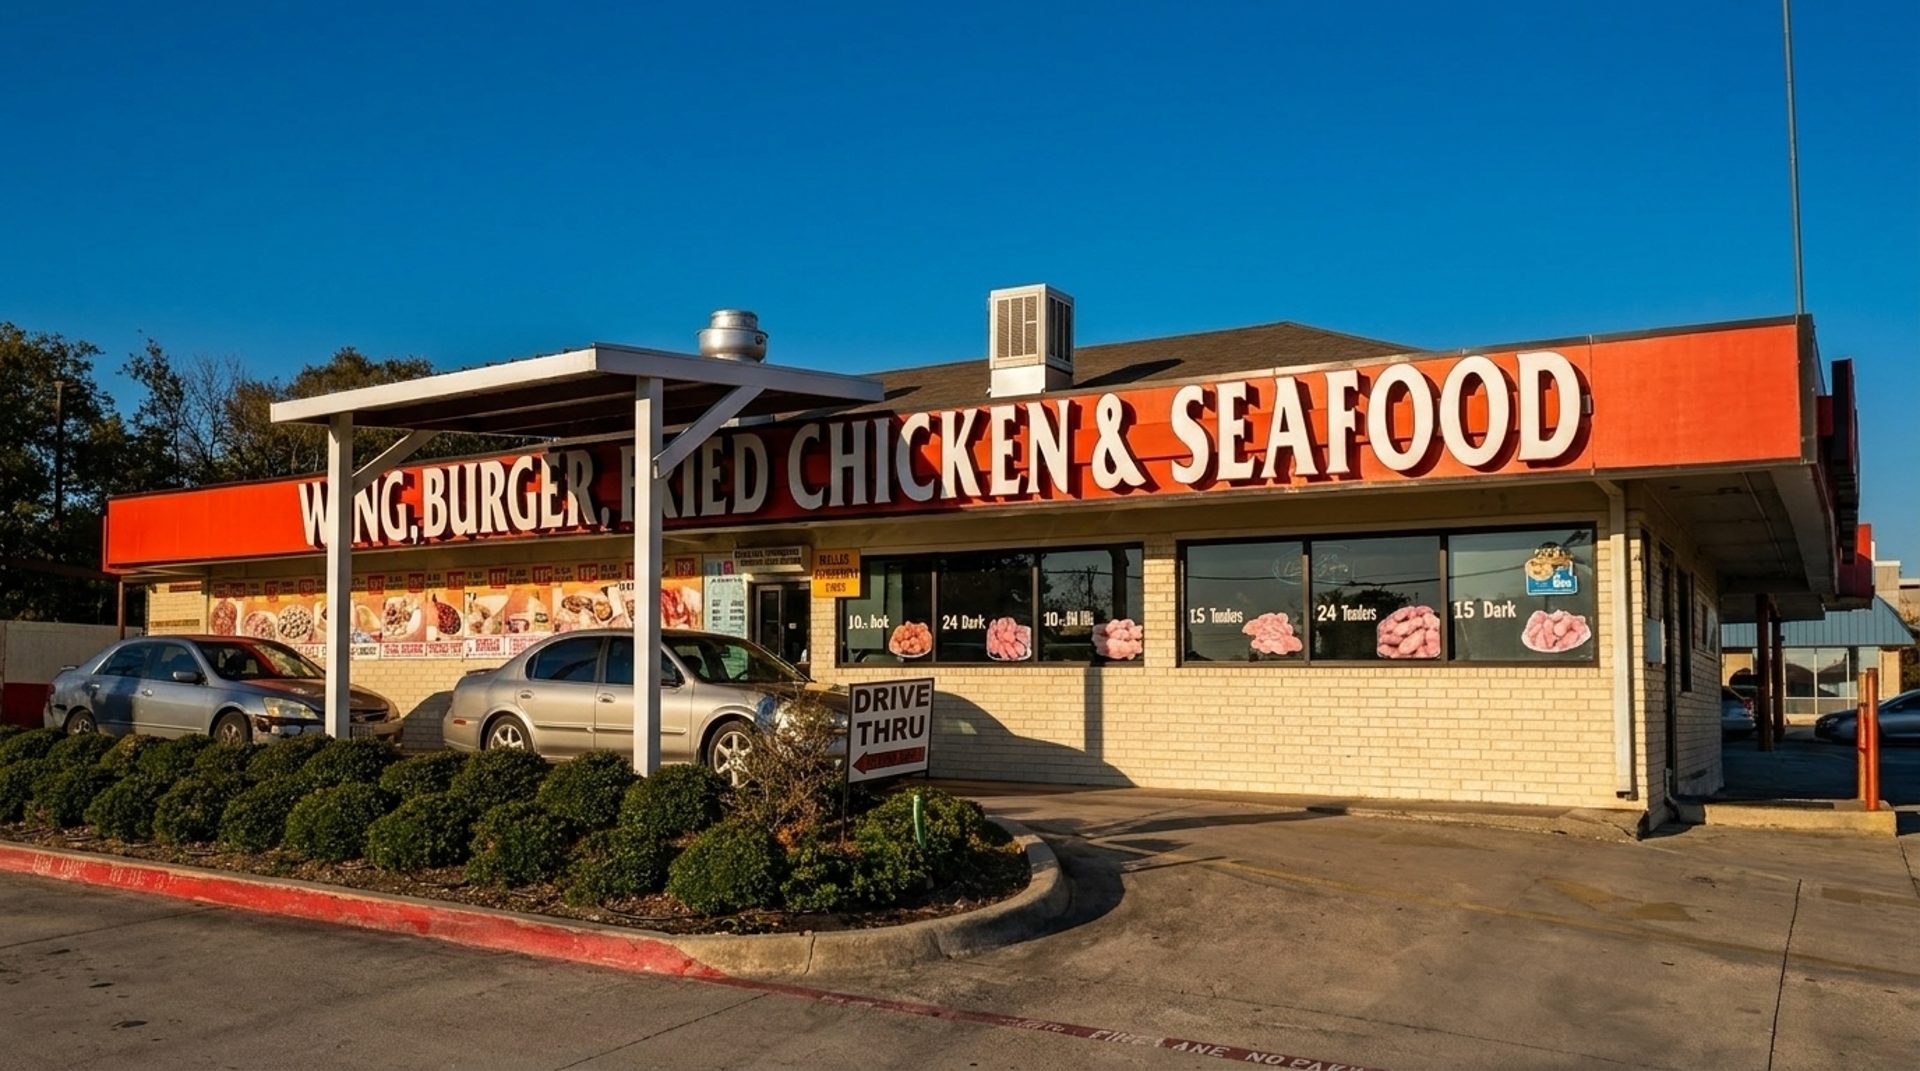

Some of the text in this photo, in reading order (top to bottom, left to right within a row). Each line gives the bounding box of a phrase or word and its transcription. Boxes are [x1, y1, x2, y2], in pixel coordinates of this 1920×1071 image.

[298, 469, 418, 546] WNG,
[422, 448, 611, 538] BURGER,
[788, 399, 1070, 511] CHICKEN
[1092, 392, 1147, 491] &
[1170, 351, 1582, 485] SEAFOOD
[1317, 604, 1337, 621] 24
[1454, 600, 1517, 619] 15 Dark
[870, 614, 889, 629] hot
[942, 614, 958, 630] 24
[854, 684, 930, 714] DRIVE
[856, 715, 925, 747] THRU
[1245, 1051, 1286, 1066] NO
